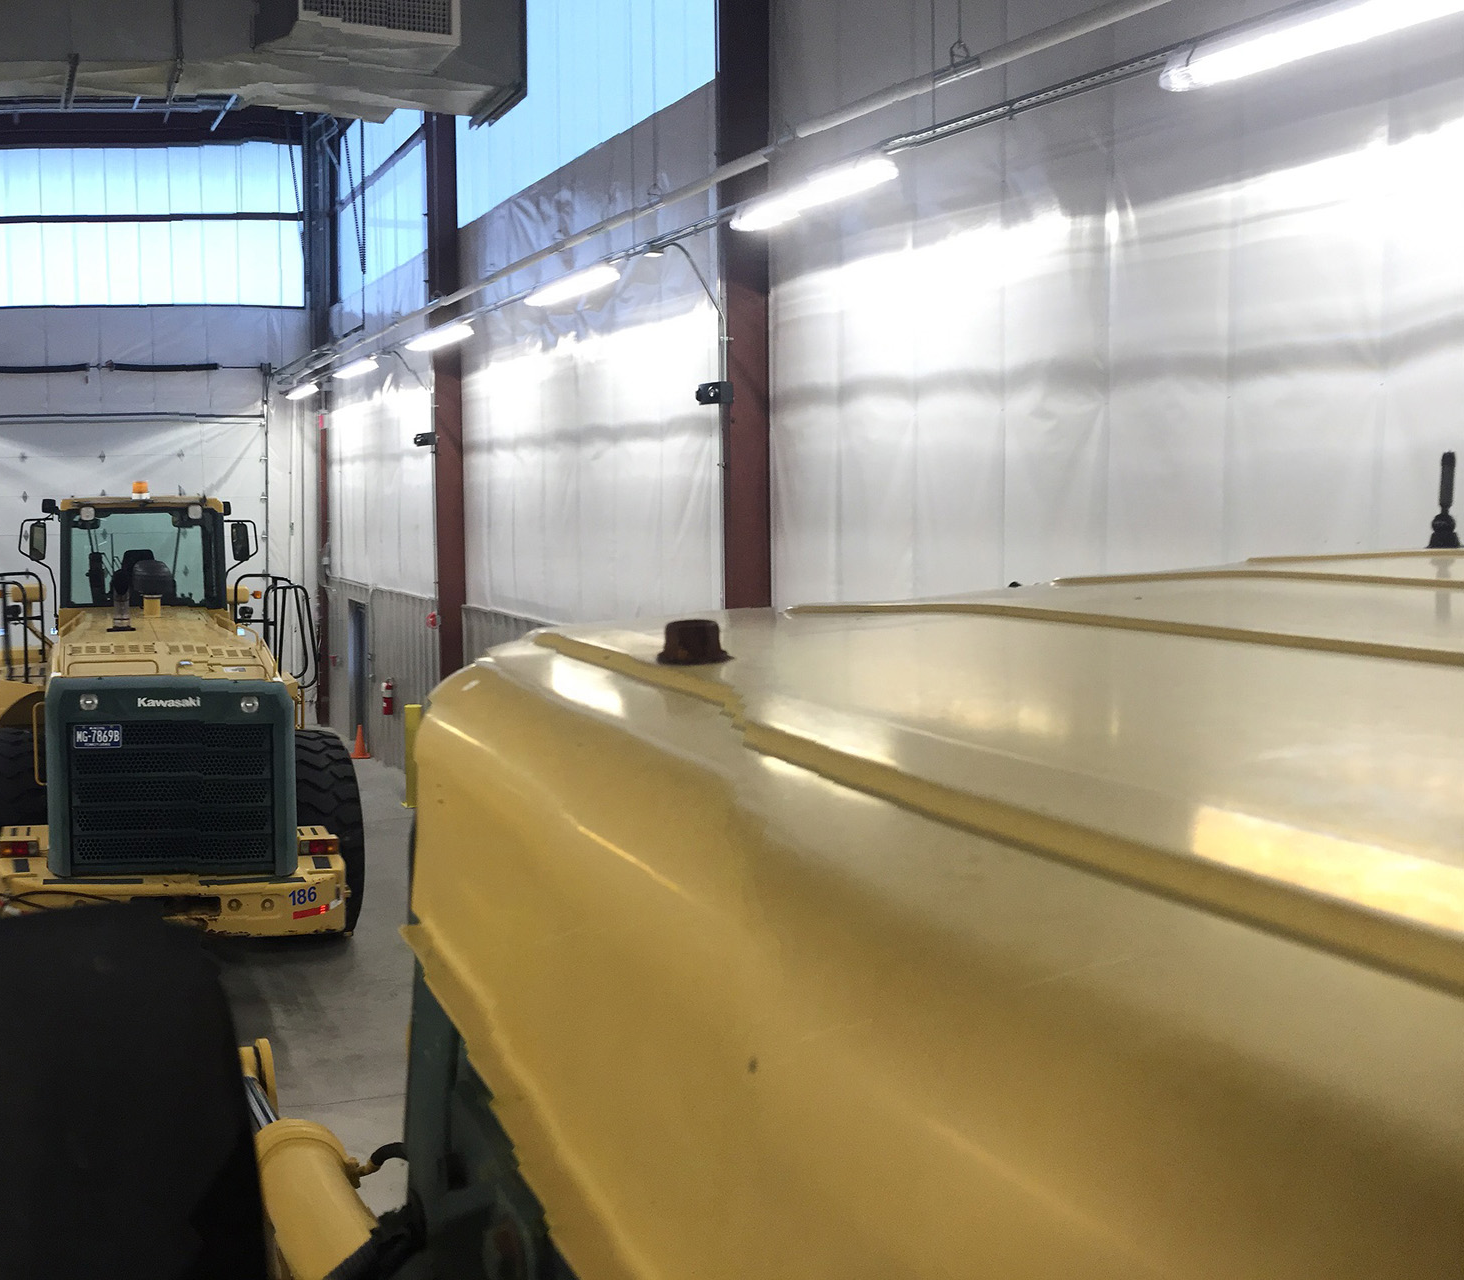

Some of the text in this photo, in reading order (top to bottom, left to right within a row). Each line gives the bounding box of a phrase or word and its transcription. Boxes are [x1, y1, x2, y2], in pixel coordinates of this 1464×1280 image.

[137, 696, 201, 708] Kawasaki
[76, 730, 120, 743] MG-7869B
[289, 886, 317, 906] 186
